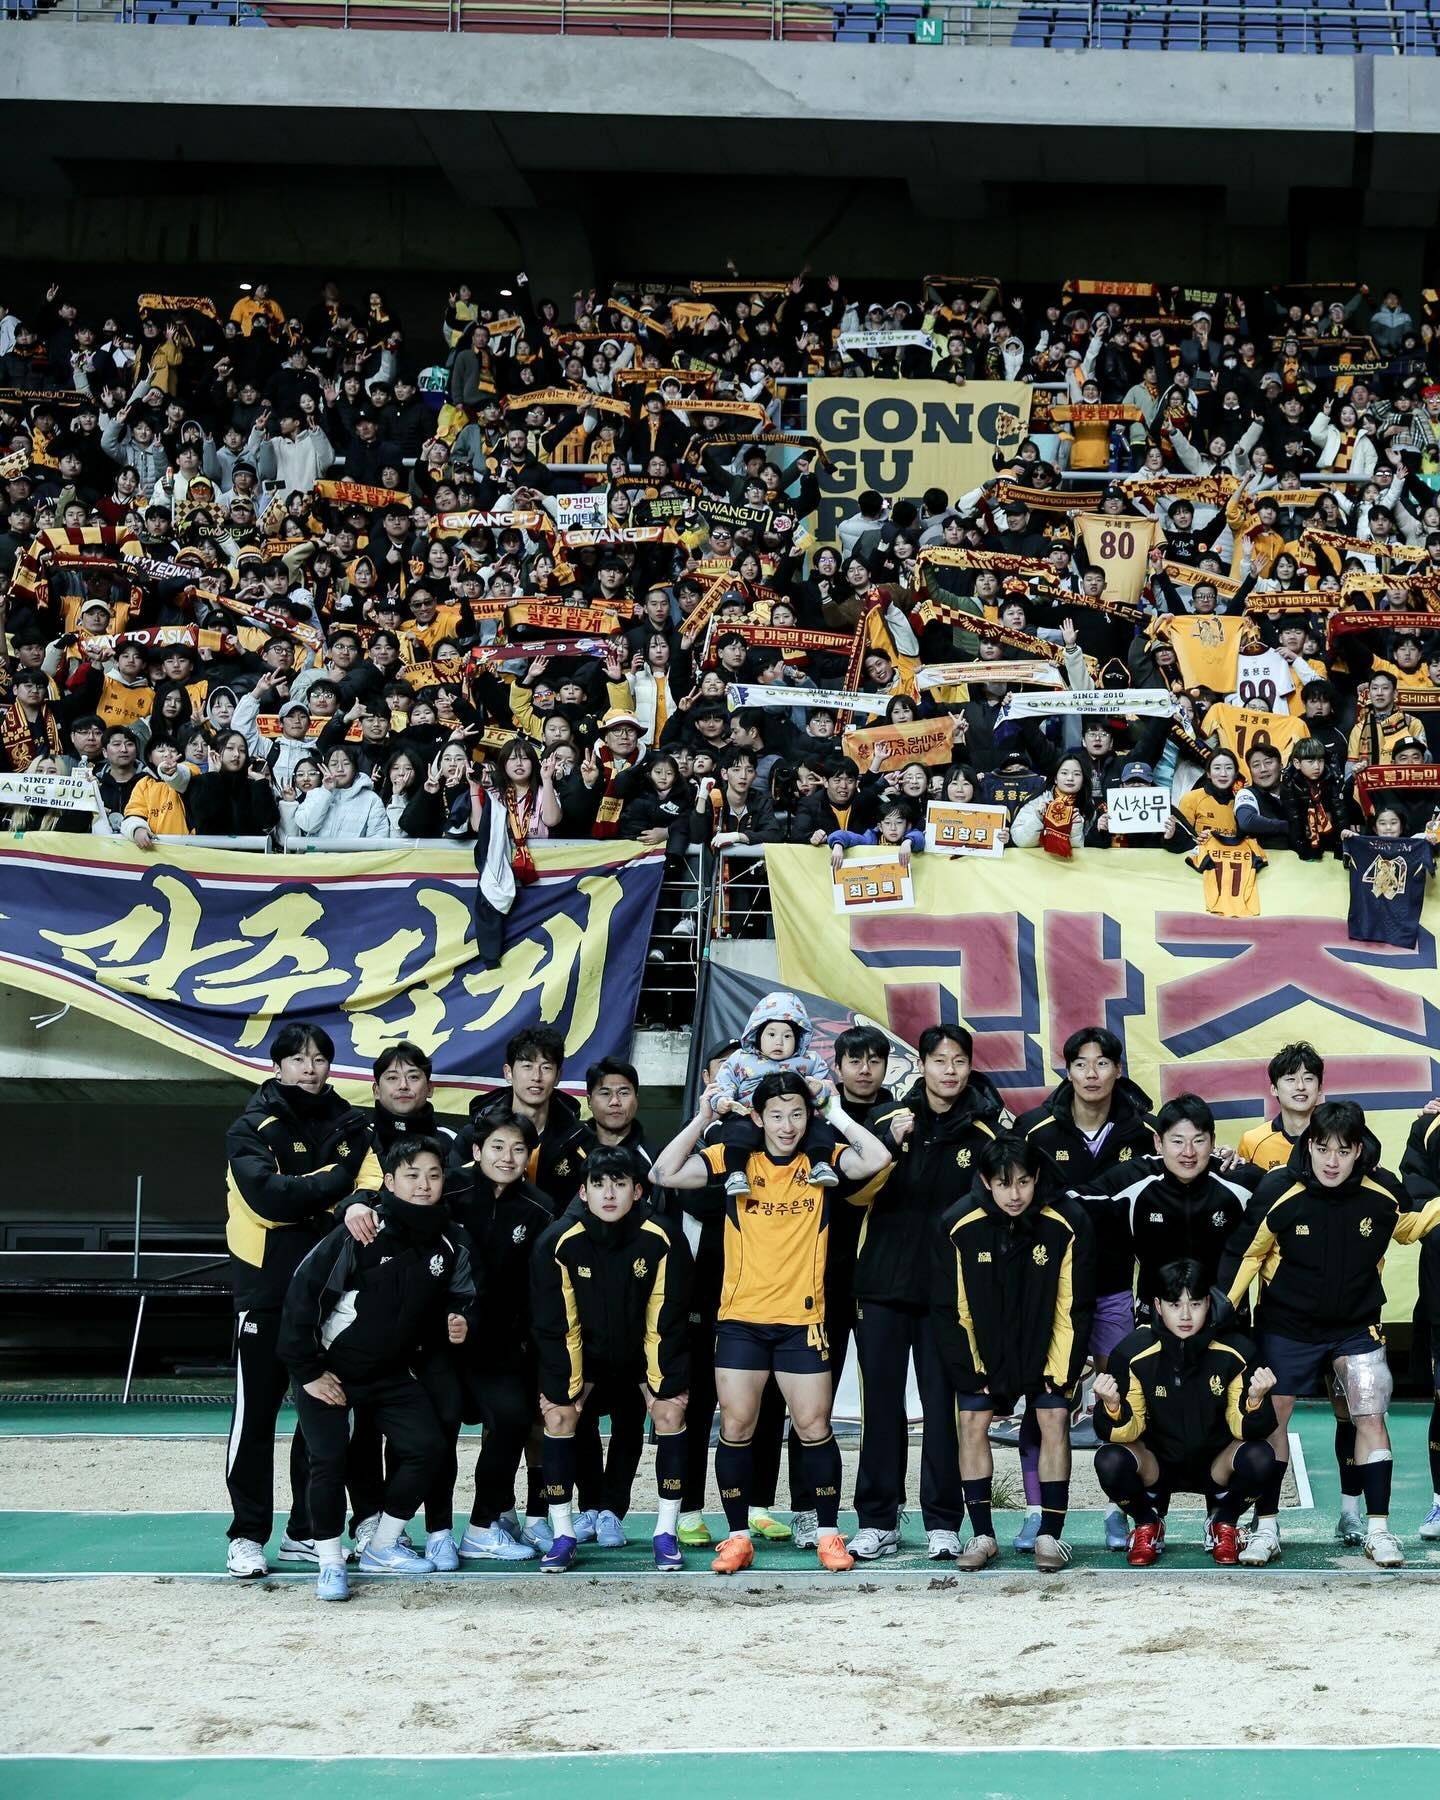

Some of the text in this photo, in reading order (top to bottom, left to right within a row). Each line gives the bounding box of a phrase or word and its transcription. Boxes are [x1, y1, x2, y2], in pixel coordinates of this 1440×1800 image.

[922, 21, 936, 36] N
[816, 449, 914, 494] GU
[698, 499, 766, 522] GWANGJU
[565, 527, 662, 545] GWANGJU
[1099, 531, 1135, 560] 80
[1279, 595, 1330, 607] FOOTBALL
[125, 631, 151, 645] TO
[153, 627, 195, 647] ASIA
[1072, 692, 1100, 700] SINCE
[1400, 694, 1430, 704] SHINE
[485, 731, 507, 743] FC
[907, 732, 945, 747] SHINE
[23, 776, 83, 789] SINCE 2010
[1112, 794, 1168, 823] 신창무
[941, 825, 989, 842] 신창무
[849, 880, 896, 897] 최경록
[760, 1198, 815, 1218] 광주은행
